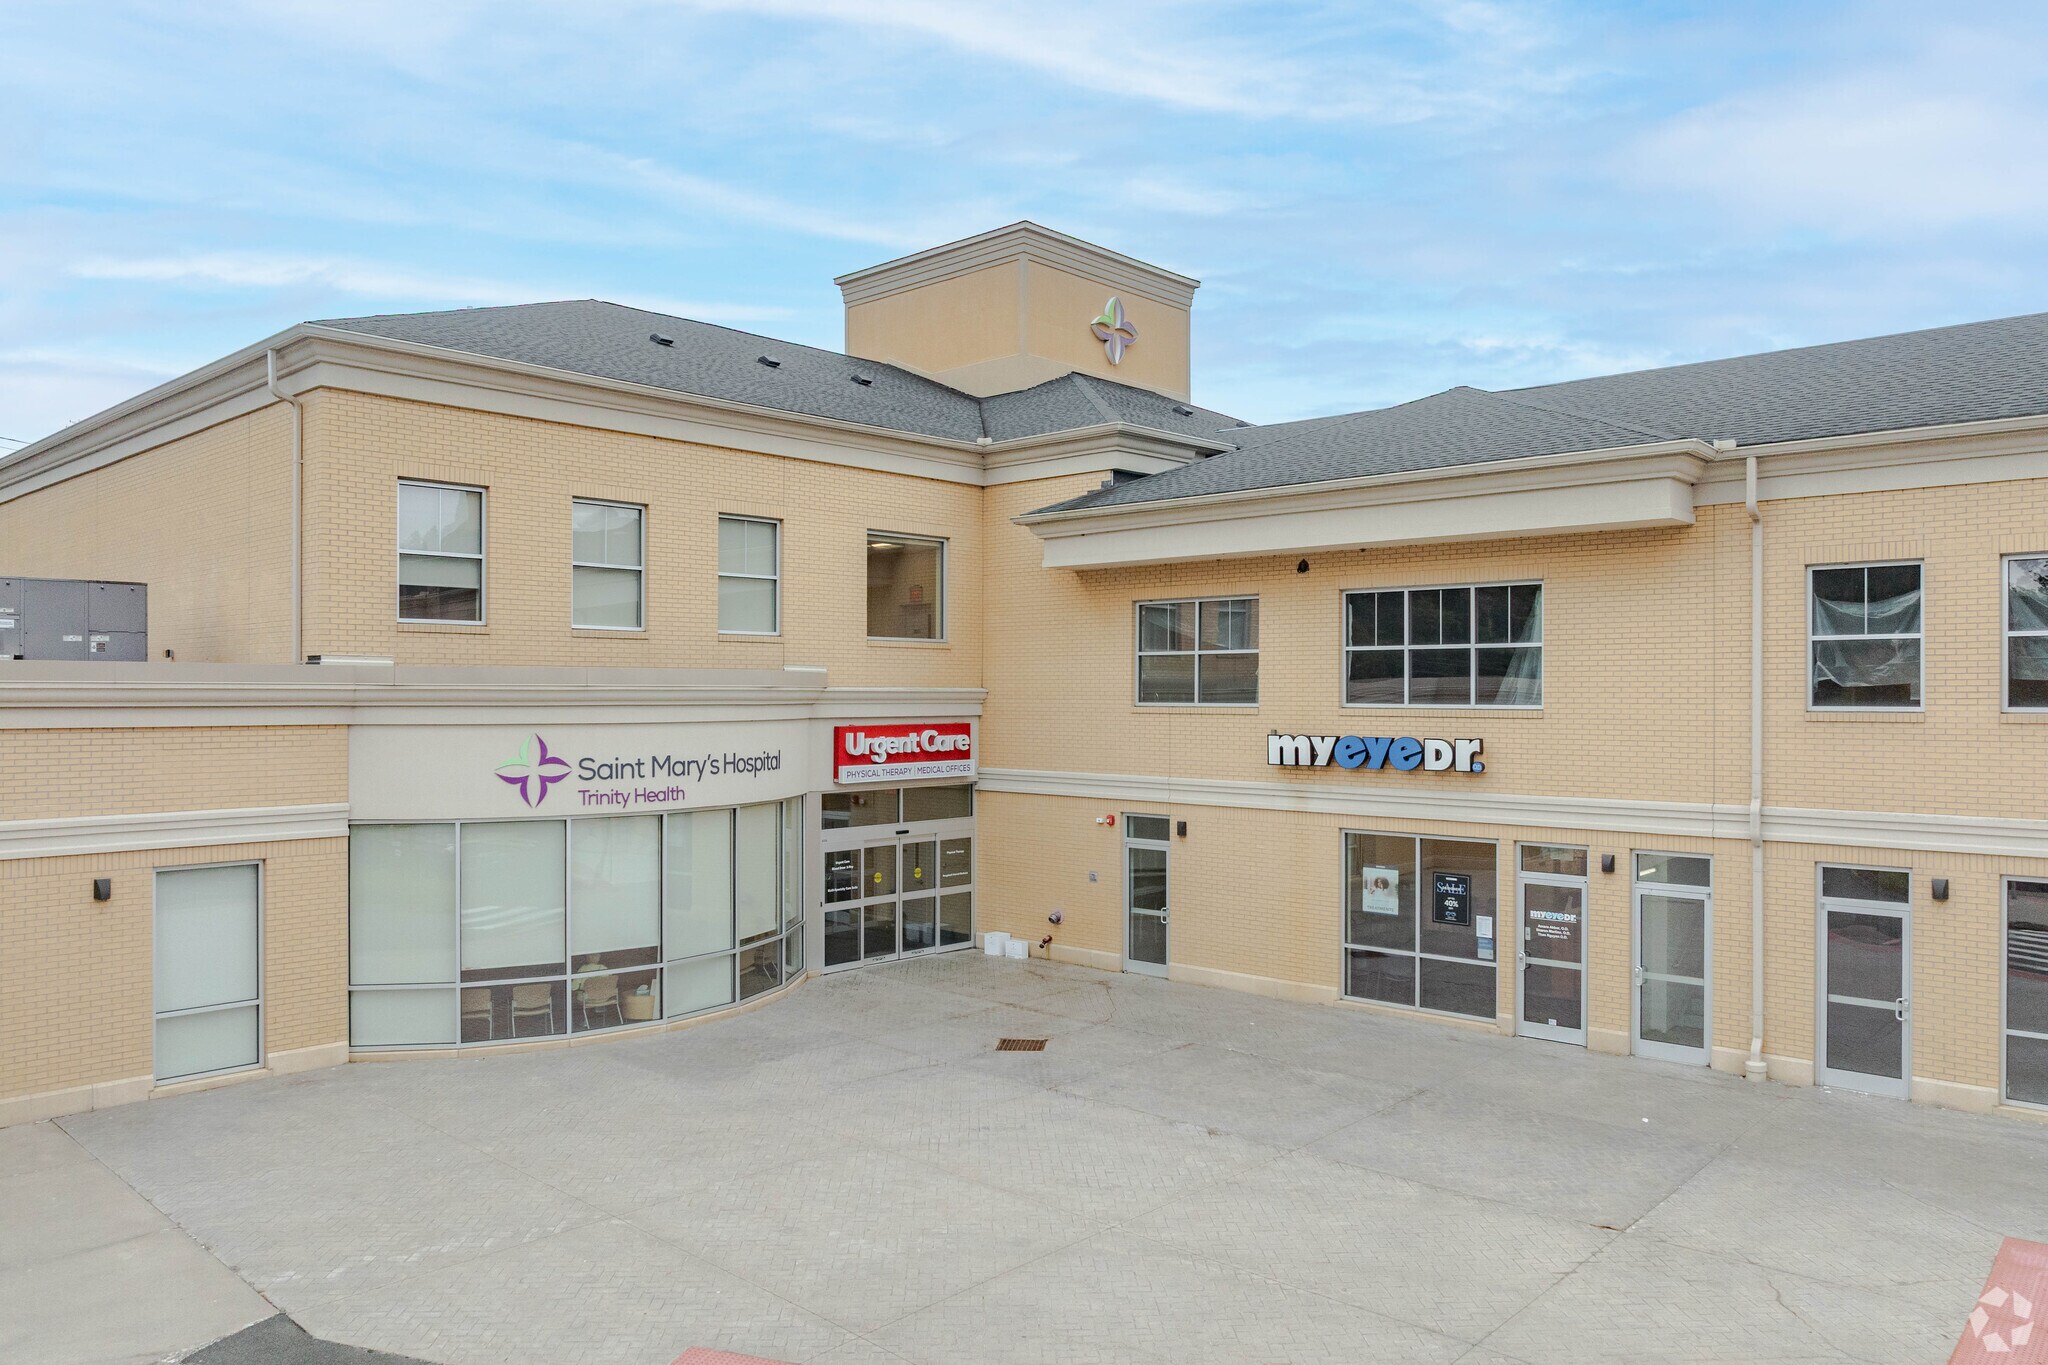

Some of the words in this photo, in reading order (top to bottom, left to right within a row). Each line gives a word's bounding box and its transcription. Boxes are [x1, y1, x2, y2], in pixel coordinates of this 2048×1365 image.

[845, 731, 920, 763] Urgent
[920, 729, 971, 753] Care
[577, 756, 646, 781] Saint
[651, 753, 720, 783] Mary's
[723, 749, 781, 778] Hospital
[846, 770, 881, 779] PHYSICAL
[881, 767, 912, 777] THERAPY
[916, 765, 944, 775] MEDICAL
[945, 763, 971, 773] OFFICES
[577, 788, 631, 809] Trinity
[634, 785, 685, 803] Health
[1436, 881, 1467, 896] SALE
[1443, 899, 1459, 908] 40%
